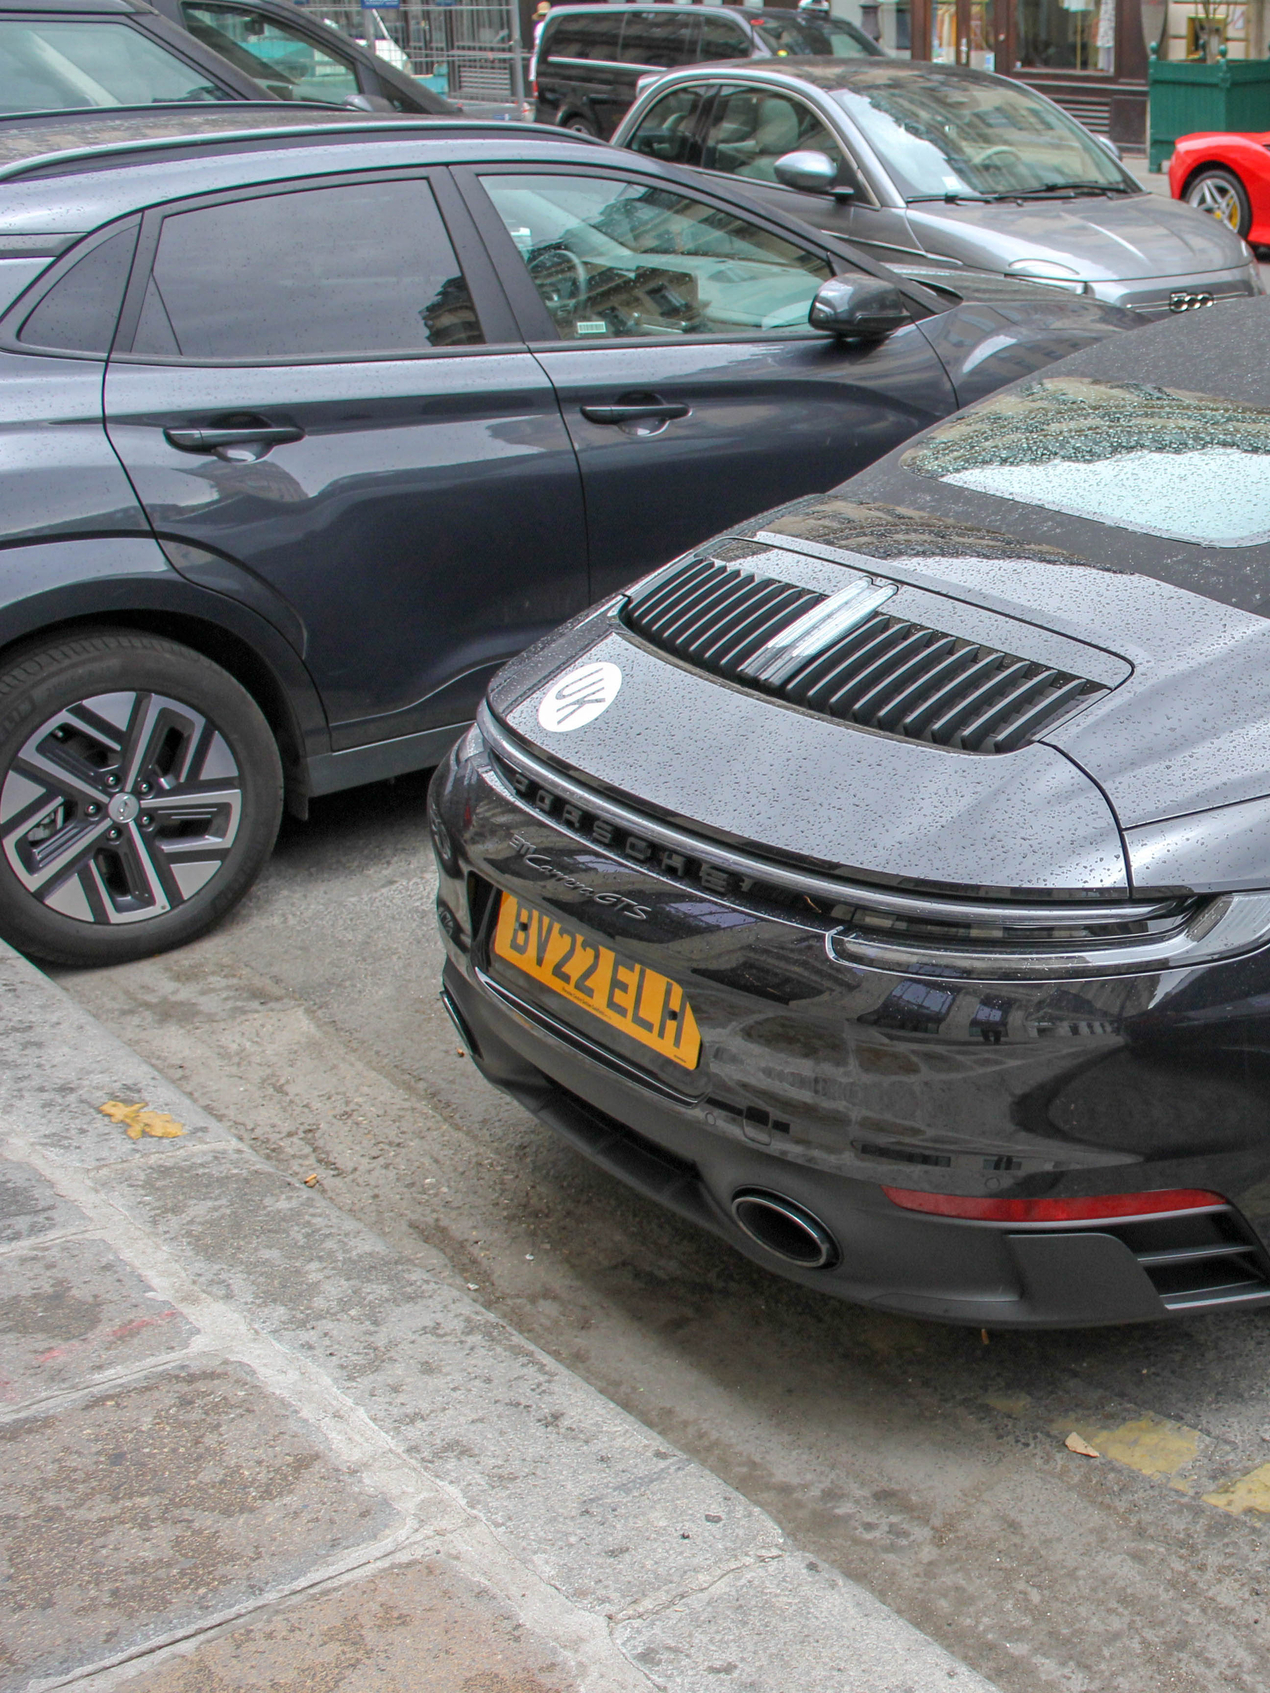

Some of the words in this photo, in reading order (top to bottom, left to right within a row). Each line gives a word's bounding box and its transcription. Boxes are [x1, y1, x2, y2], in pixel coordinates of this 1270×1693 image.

[555, 667, 606, 725] UK
[514, 774, 728, 892] PORSCHE
[523, 854, 595, 898] Carrera
[593, 892, 652, 919] GTS
